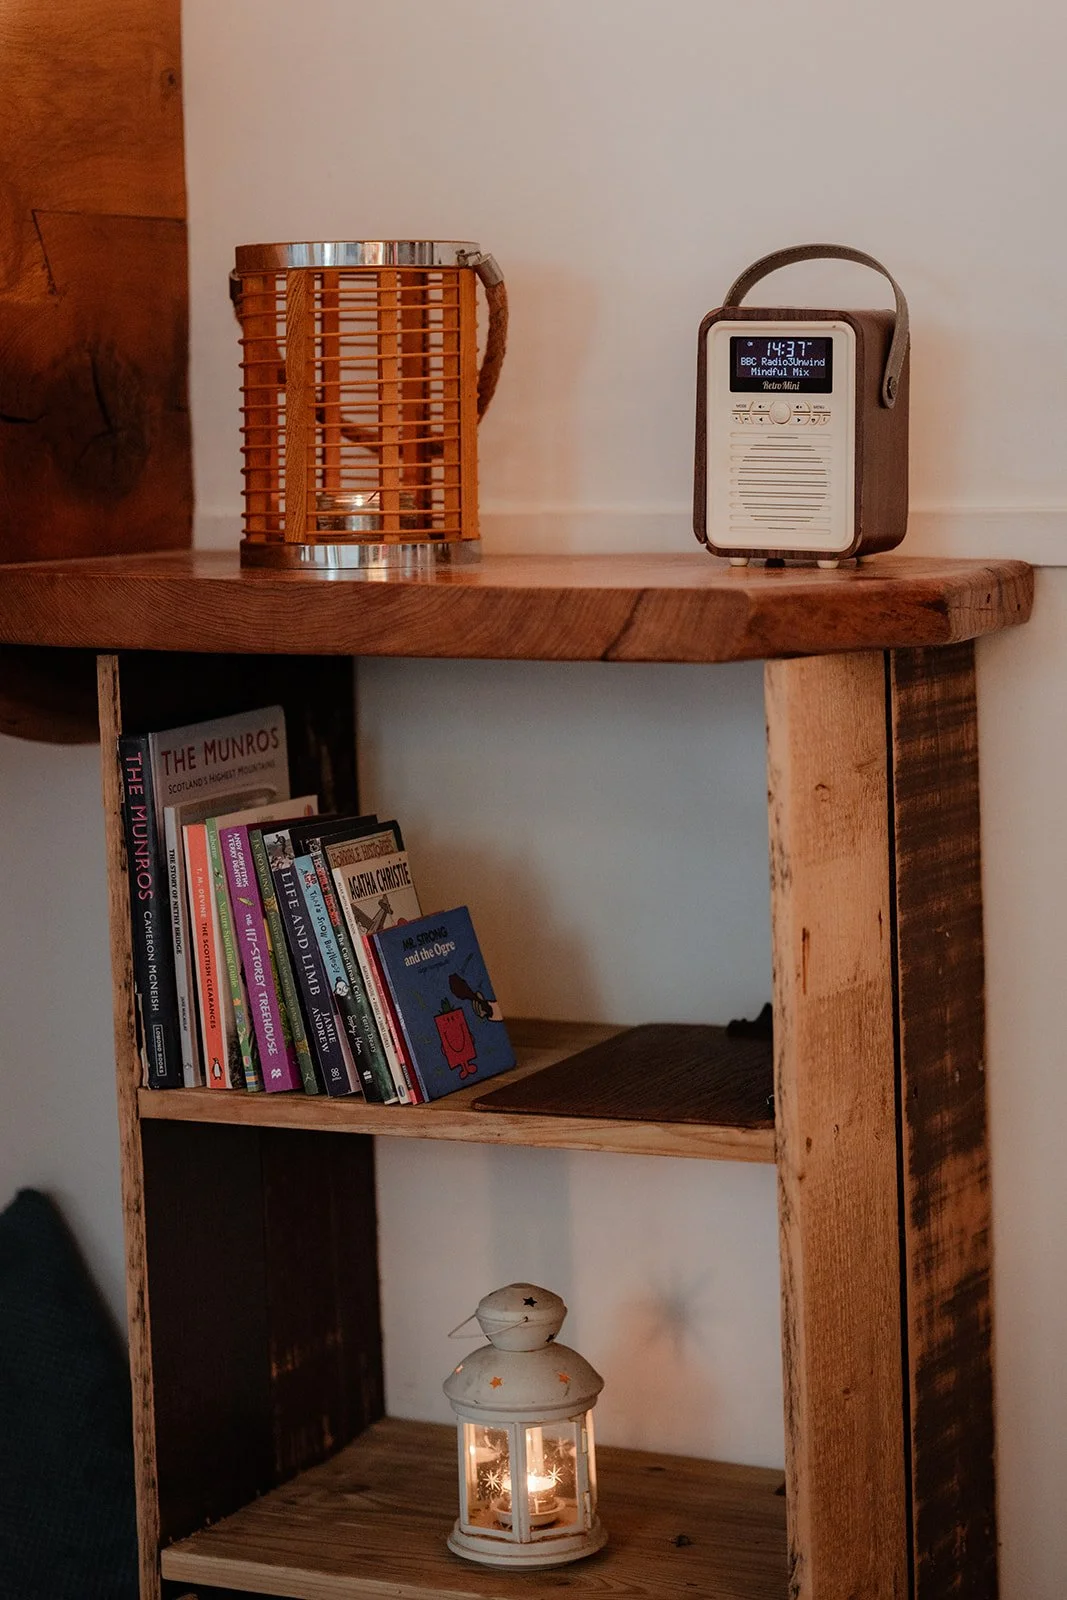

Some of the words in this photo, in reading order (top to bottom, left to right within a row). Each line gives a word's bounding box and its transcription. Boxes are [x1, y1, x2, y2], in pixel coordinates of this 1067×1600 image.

[741, 357, 757, 365] BBC
[768, 341, 806, 357] 14:37
[751, 368, 787, 376] Mindful
[793, 368, 809, 376] Mix
[762, 380, 782, 389] Retro
[782, 380, 800, 390] Mini
[161, 747, 196, 775] THE
[204, 728, 279, 765] MUNROS
[126, 752, 144, 795] THE
[169, 777, 207, 794] SCOTLAND'S
[209, 770, 236, 783] HIGHEST
[131, 804, 154, 900] MUNROS
[256, 853, 270, 895] ROWLING
[348, 872, 378, 900] AGATHA
[376, 858, 410, 892] CHRISTIE
[173, 889, 177, 900] OF
[219, 901, 229, 928] Nature
[144, 910, 155, 961] CAMERON
[223, 930, 235, 963] Spotting
[281, 870, 300, 910] LIFE
[291, 912, 309, 950] AND
[301, 953, 321, 996] LIMB
[337, 932, 346, 947] The
[403, 938, 416, 951] MR.
[417, 927, 448, 946] STRONG
[404, 951, 421, 966] and
[421, 948, 434, 961] the
[434, 941, 456, 956] Ogre
[203, 939, 211, 976] SCOTTISH
[207, 978, 215, 1029] CLEARANCES
[229, 965, 238, 987] Guide
[246, 927, 266, 988] 117-STOREY
[258, 991, 278, 1056] TREEHOUSE
[312, 1005, 329, 1054] ANDREW
[321, 1010, 336, 1044] JAMIE
[361, 1013, 370, 1031] Terry
[367, 1032, 377, 1053] Deary
